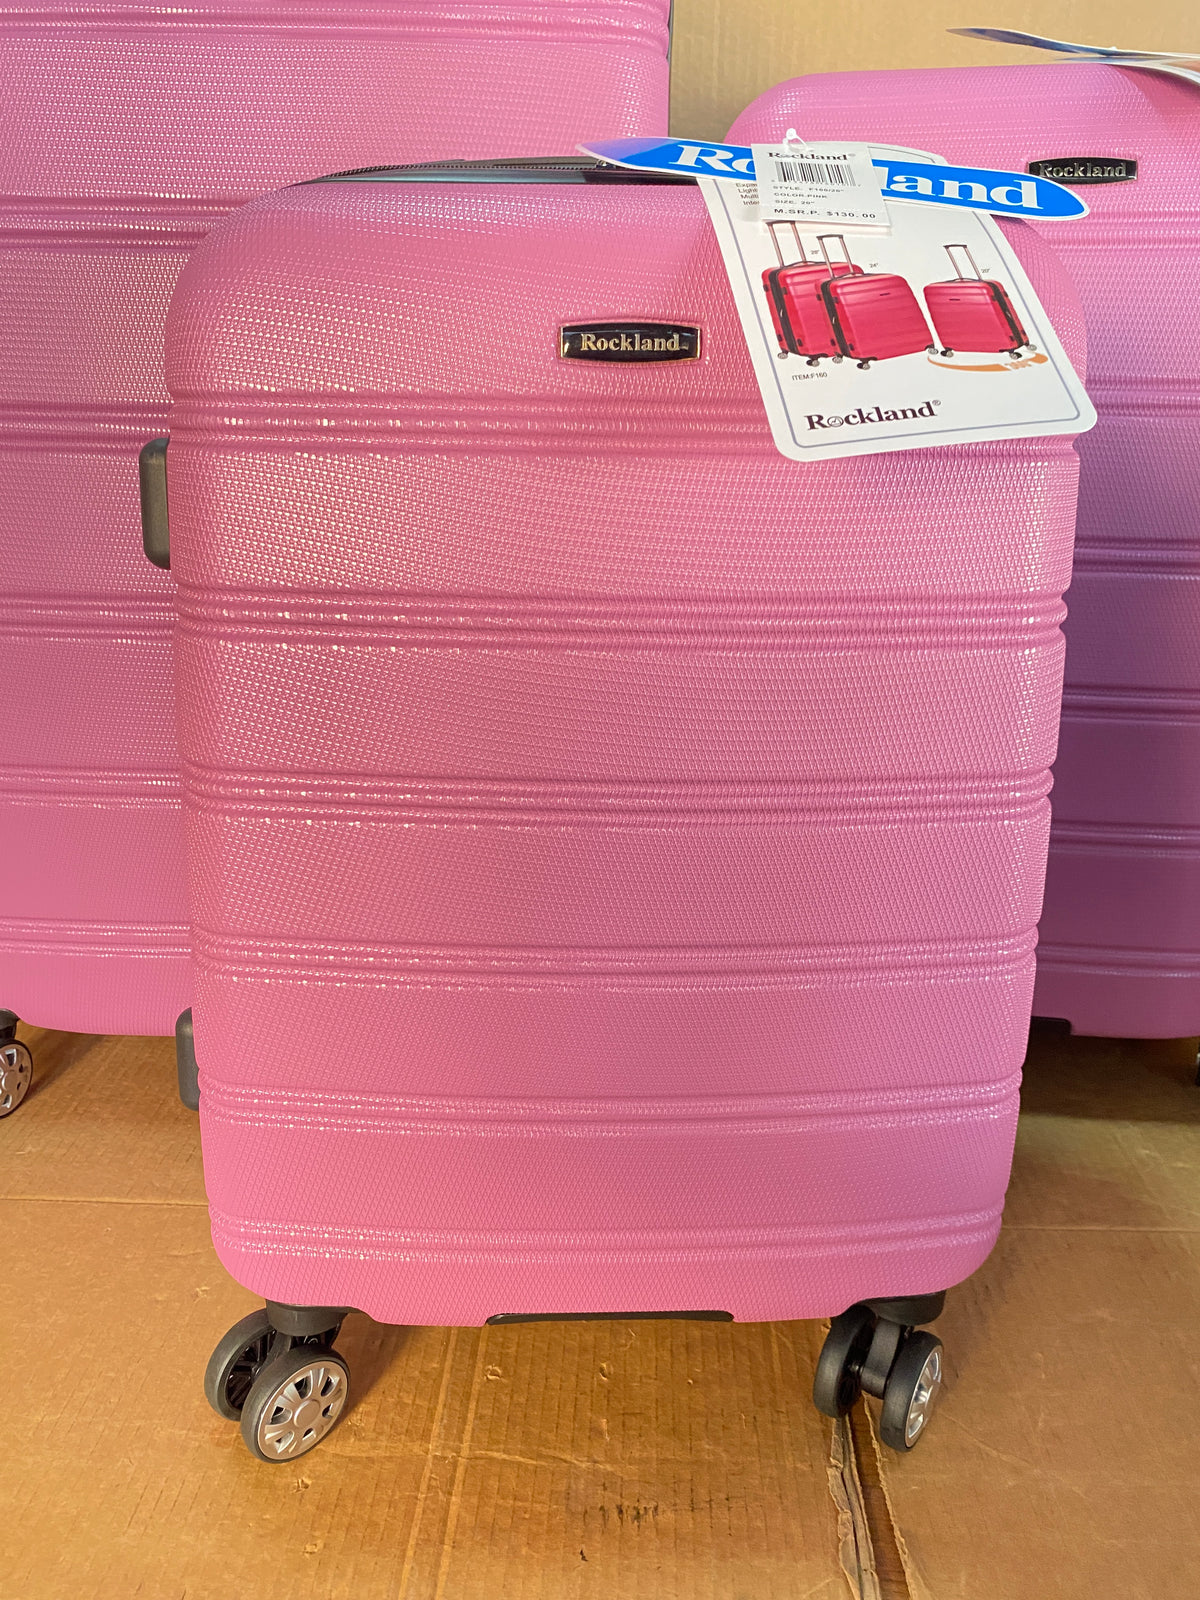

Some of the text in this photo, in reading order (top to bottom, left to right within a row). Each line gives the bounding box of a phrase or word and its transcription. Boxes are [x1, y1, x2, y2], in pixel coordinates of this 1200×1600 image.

[668, 144, 1043, 210] Roland
[1038, 162, 1127, 178] Rockland
[580, 333, 680, 351] Rockland
